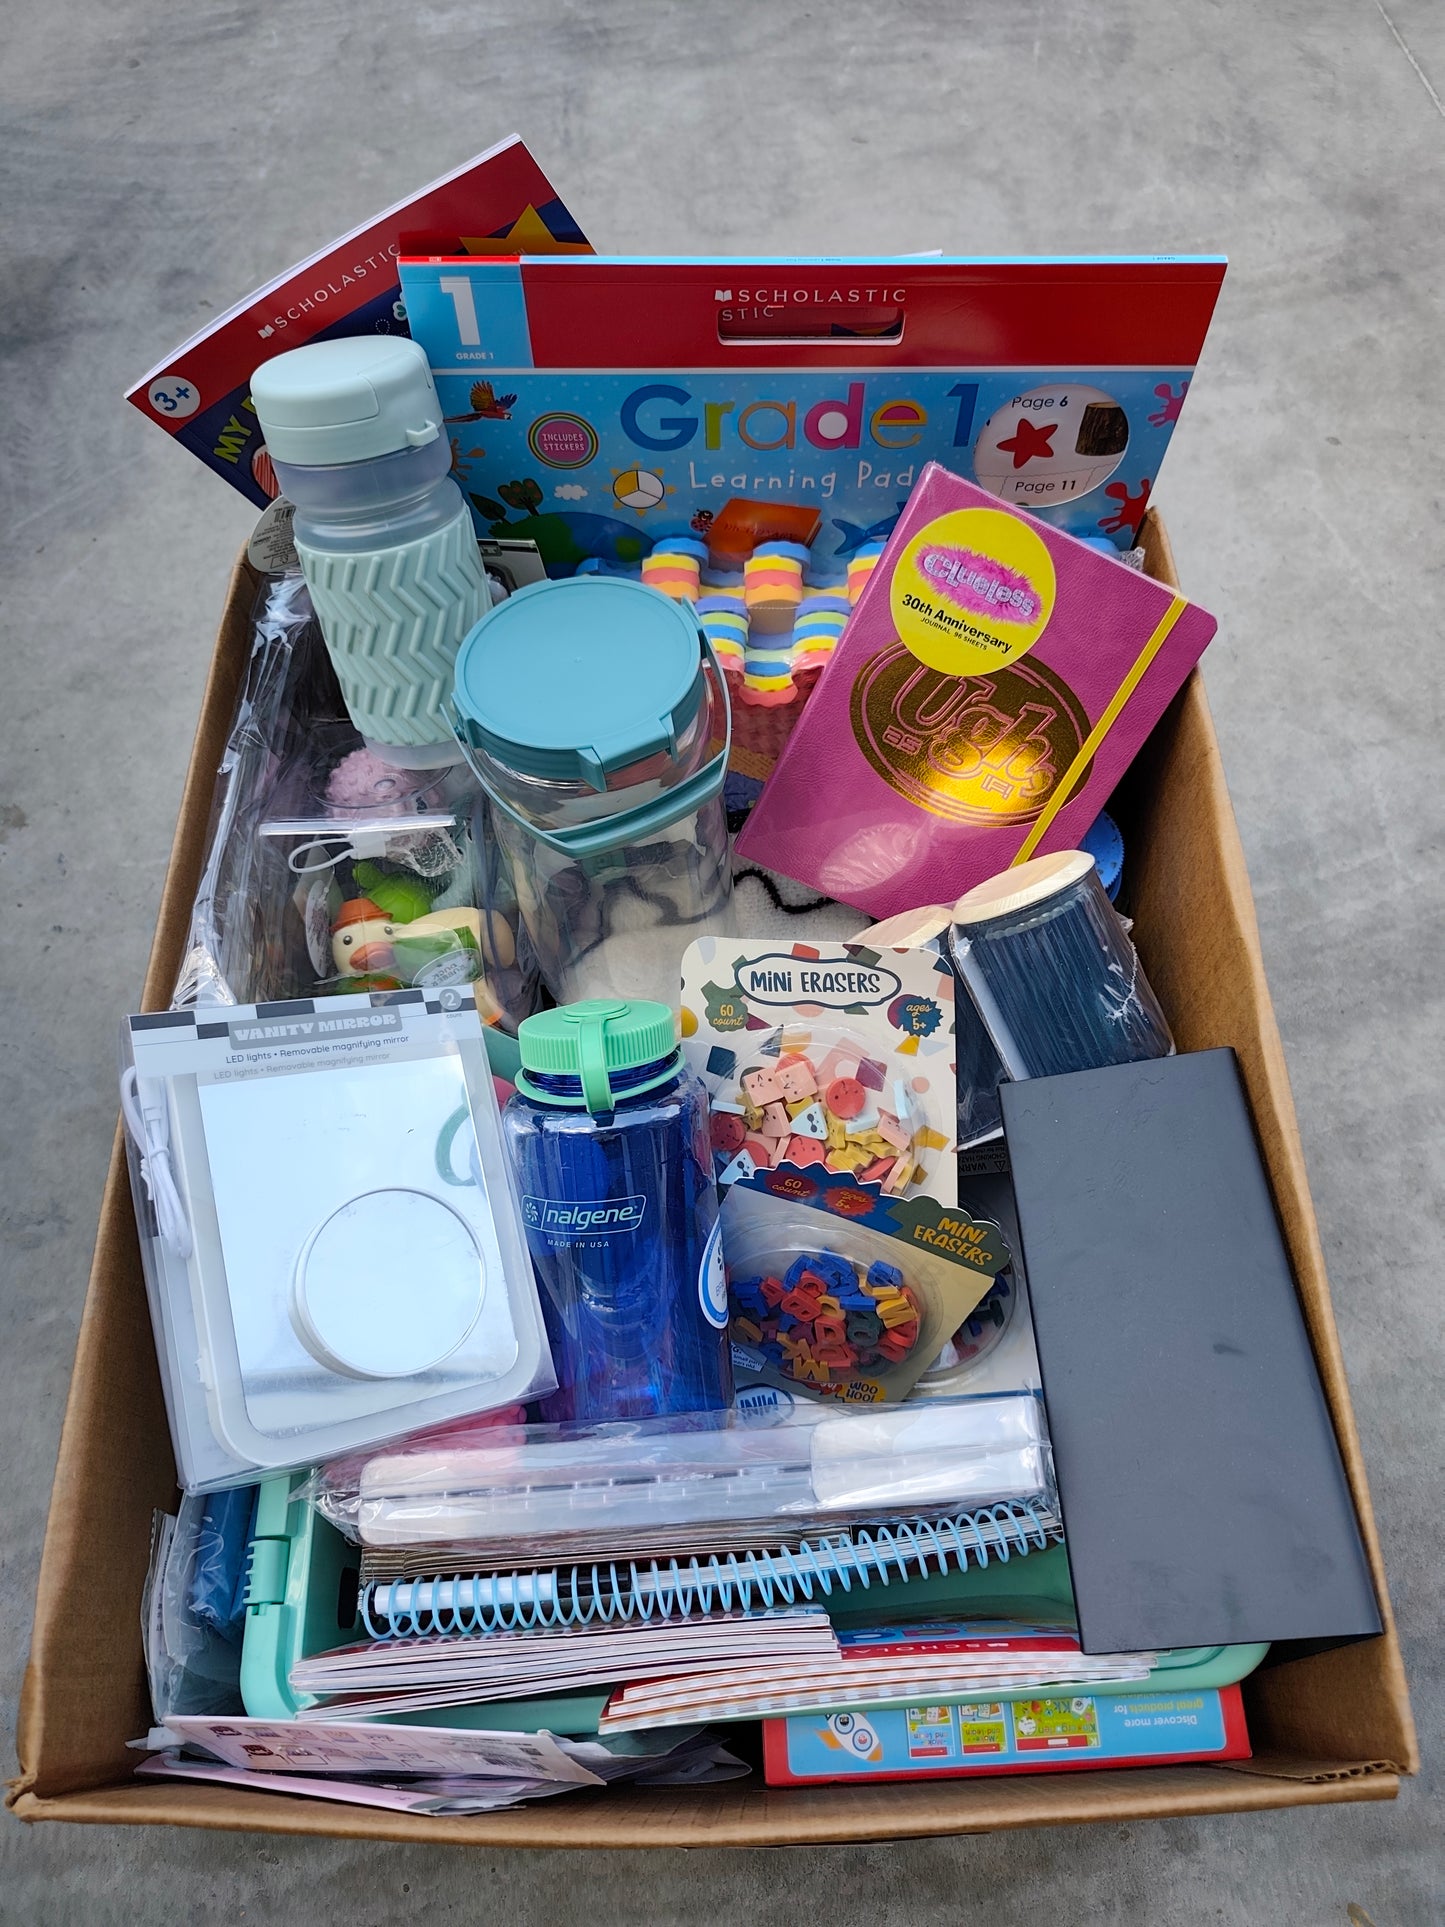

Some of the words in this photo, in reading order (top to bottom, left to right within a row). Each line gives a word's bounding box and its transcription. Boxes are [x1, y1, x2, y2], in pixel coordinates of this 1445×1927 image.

[274, 244, 401, 329] SCHOLASTIC
[738, 289, 906, 302] SCHOLASTIC
[439, 276, 481, 346] 1
[455, 352, 485, 360] GRADE
[487, 352, 494, 360] 1
[154, 383, 190, 412] 3+
[1011, 396, 1054, 411] Page
[1060, 396, 1069, 407] 6
[621, 382, 928, 452] Grade
[946, 384, 980, 448] 1
[213, 414, 252, 465] MY
[542, 433, 584, 442] INCLUDES
[543, 442, 585, 451] STICKERS
[689, 461, 837, 498] Learning
[857, 460, 914, 489] Pad
[1014, 481, 1055, 494] Page
[1062, 480, 1076, 491] 11
[902, 594, 933, 617] 30th
[933, 610, 1012, 654] Anniversary
[921, 617, 951, 634] JOURNAL
[954, 631, 963, 640] 96
[963, 636, 988, 651] SHEETS
[892, 664, 1057, 798] Ugh
[801, 972, 880, 994] ERASERS
[445, 992, 456, 1007] 2
[720, 1004, 733, 1017] 60
[906, 1003, 932, 1017] ages
[233, 1022, 315, 1041] VANITY
[318, 1013, 397, 1033] MIRROR
[713, 1016, 744, 1026] count
[912, 1018, 927, 1029] 5+
[226, 1054, 245, 1064] LED
[246, 1051, 272, 1063] lights
[280, 1045, 330, 1057] Removable
[332, 1038, 381, 1052] magnifying
[383, 1035, 410, 1045] mirror
[959, 1162, 988, 1173] WARN
[771, 1184, 811, 1197] count
[784, 1178, 802, 1190] 60
[546, 1206, 641, 1231] nalgene
[547, 1239, 572, 1249] MADE
[575, 1241, 586, 1249] IN
[590, 1241, 609, 1249] USA
[913, 1224, 993, 1266] ERASERS
[852, 1642, 980, 1655] SCHOLA
[1113, 1704, 1128, 1715] for
[1129, 1701, 1174, 1713] products
[1176, 1697, 1204, 1711] great
[1124, 1719, 1151, 1728] more
[1153, 1715, 1198, 1726] Discover
